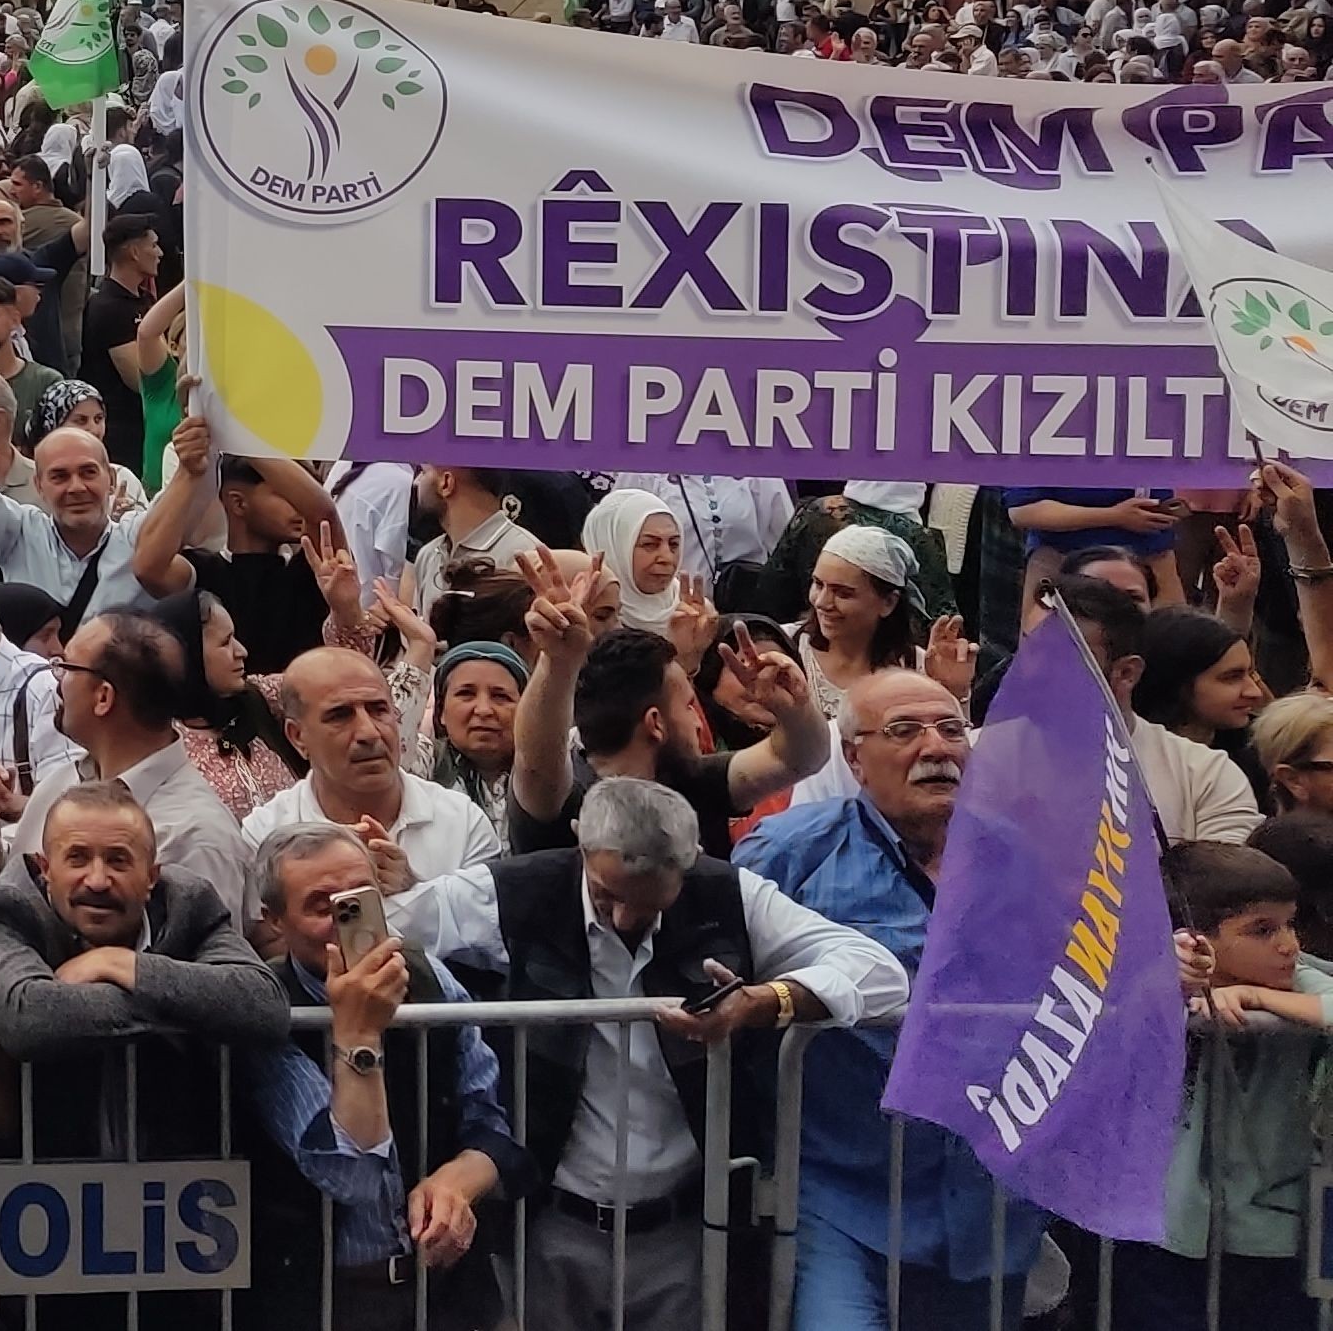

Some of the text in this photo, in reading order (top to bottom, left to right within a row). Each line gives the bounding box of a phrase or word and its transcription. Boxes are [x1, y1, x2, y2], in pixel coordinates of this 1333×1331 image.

[745, 82, 1117, 176] DEM
[250, 166, 382, 203] DEM PARTİ
[382, 347, 1279, 458] DEM PARTİ KIZILT
